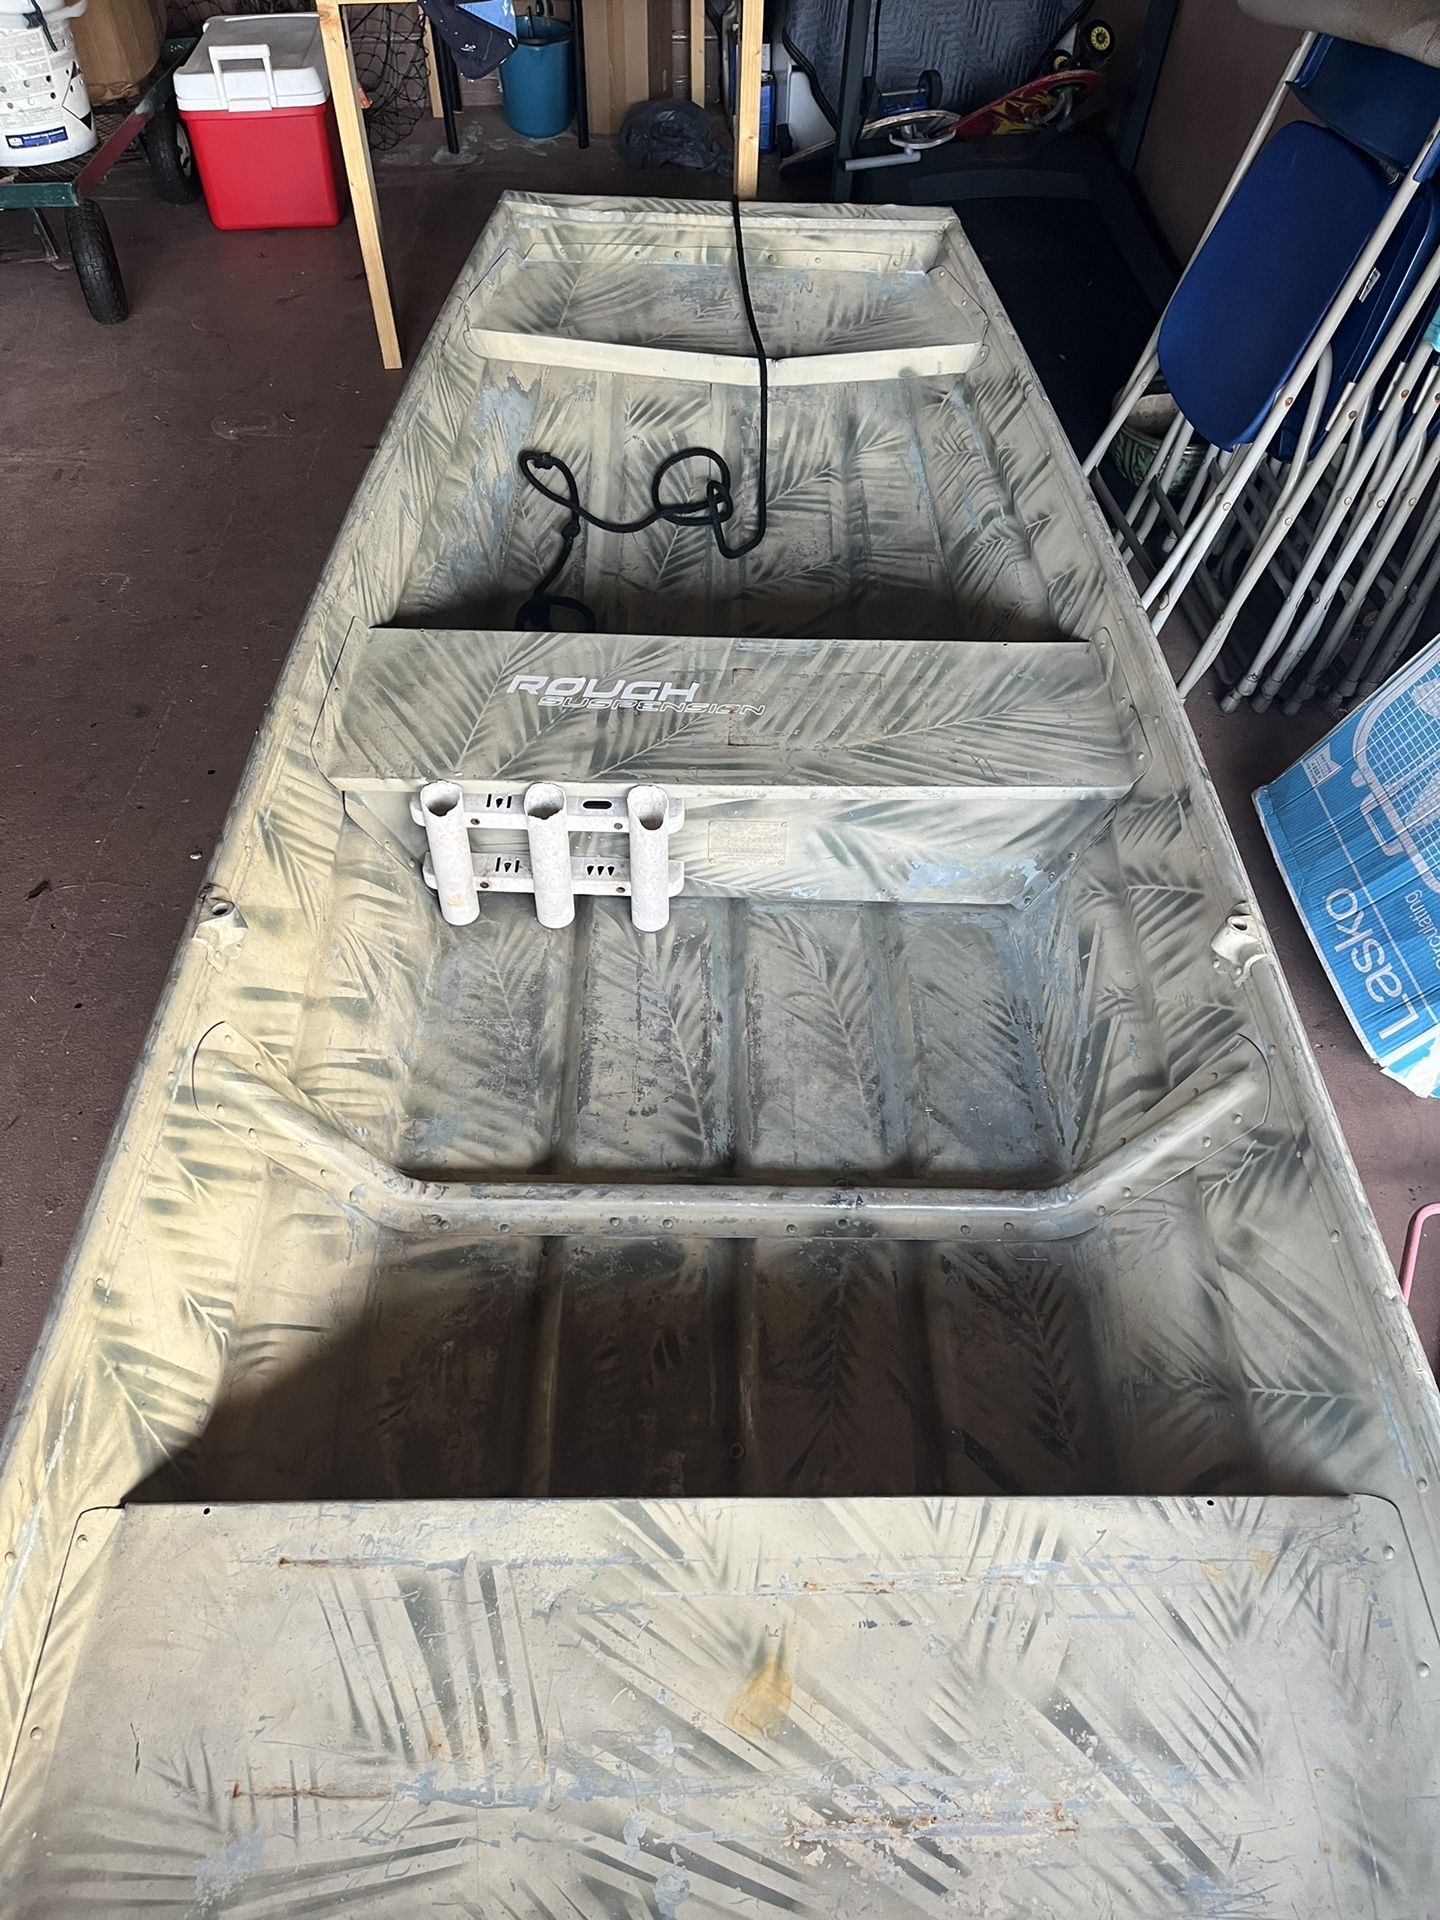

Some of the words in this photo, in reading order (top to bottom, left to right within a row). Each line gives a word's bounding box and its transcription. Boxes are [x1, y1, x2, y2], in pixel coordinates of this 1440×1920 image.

[506, 674, 700, 703] ROUGH
[537, 697, 766, 716] SUSPENSION
[1326, 888, 1418, 1040] Lasko
